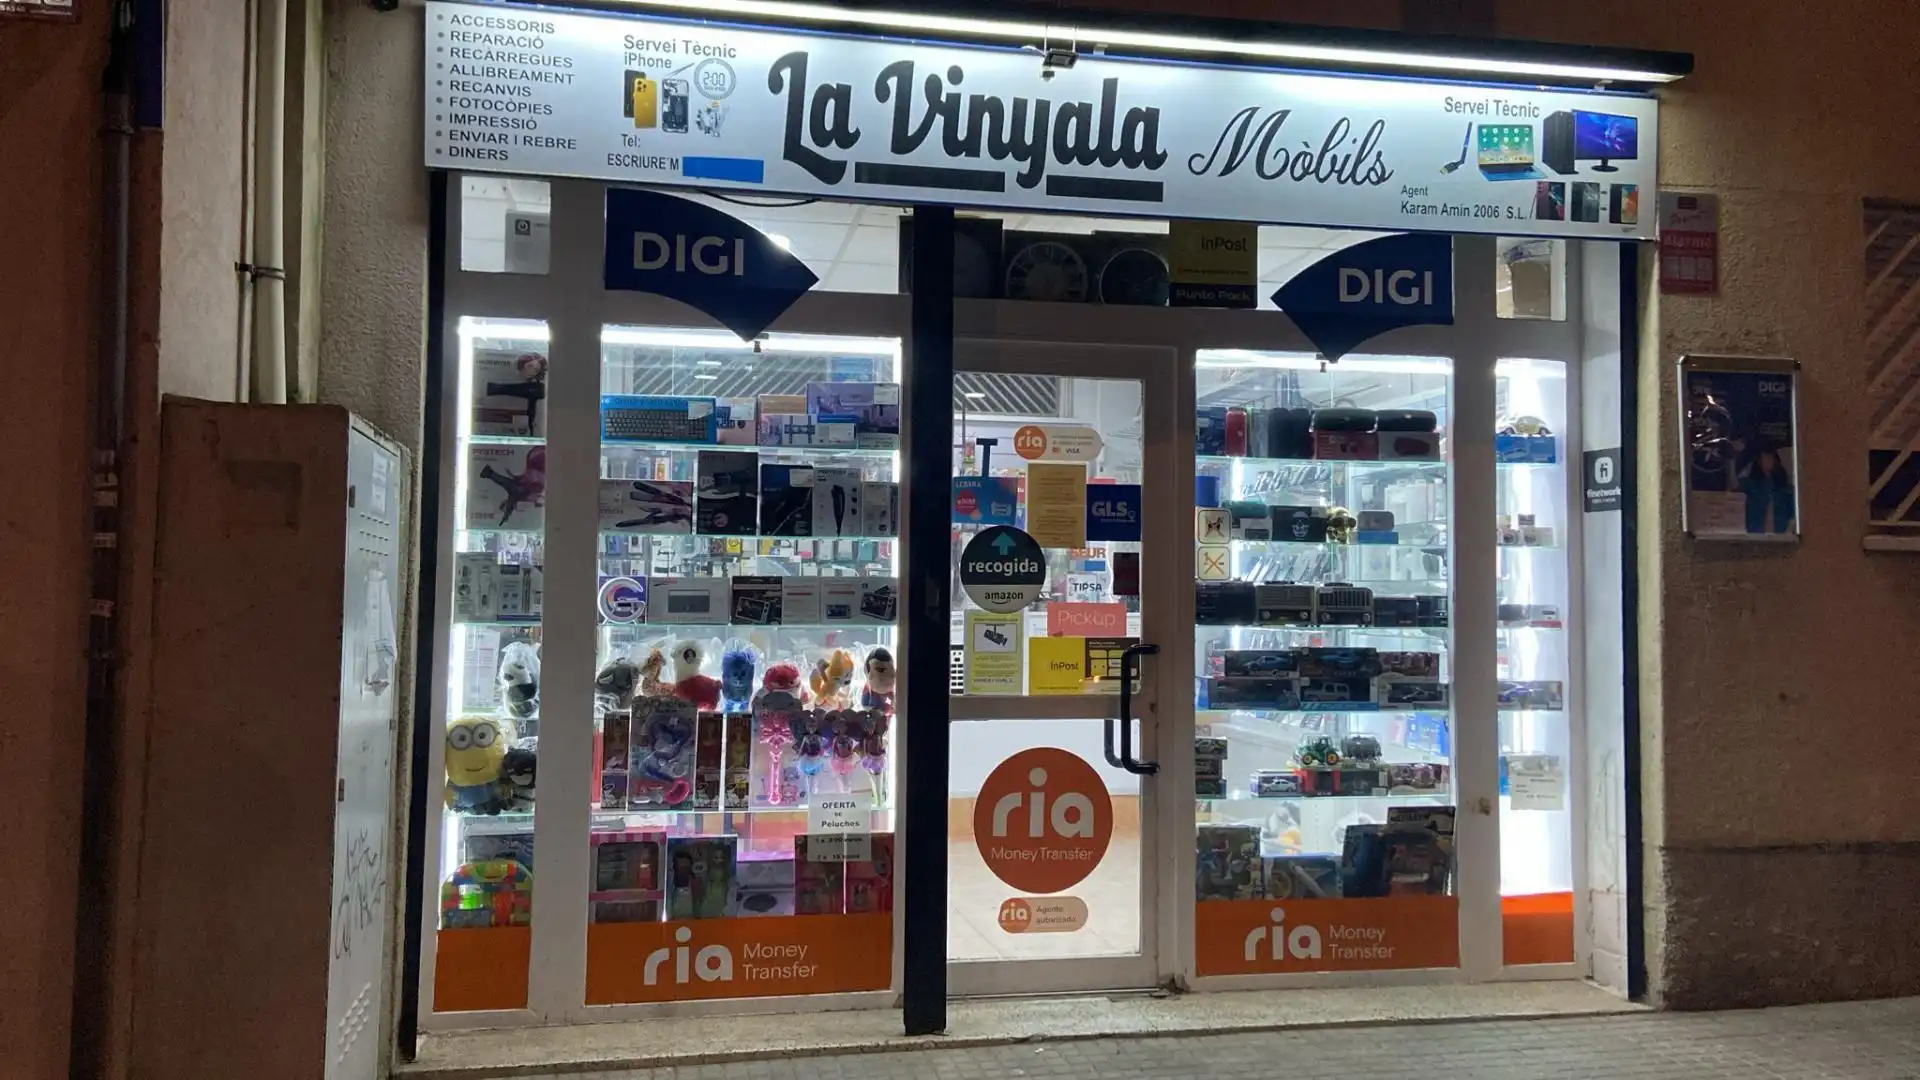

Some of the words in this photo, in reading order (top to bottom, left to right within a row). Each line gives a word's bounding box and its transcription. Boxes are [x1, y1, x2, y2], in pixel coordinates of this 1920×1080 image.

[450, 14, 555, 34] ACCESSORIS
[450, 30, 544, 49] REPARACIÓ
[624, 34, 676, 53] Servei
[682, 40, 737, 59] Tècnic
[624, 52, 672, 69] iPhone
[450, 63, 575, 85] ALLIBREAMENT
[450, 80, 532, 97] RECANVIS
[450, 96, 553, 116] FOTOCÒPIES
[1443, 97, 1490, 116] Servei
[1493, 98, 1541, 119] Tècnic
[450, 113, 538, 131] IMPRESSIÓ
[768, 51, 861, 186] La
[874, 59, 1168, 189] Vinyala
[449, 129, 509, 145] ENVIAR
[514, 134, 518, 145] I
[523, 135, 577, 150] REBRE
[621, 133, 641, 148] Tel:
[1187, 106, 1395, 186] Mòbils
[449, 146, 509, 161] DINERS
[1401, 184, 1428, 198] Agent
[1401, 201, 1438, 216] Karam
[1441, 202, 1470, 217] Amin
[1474, 204, 1500, 219] 2006
[1201, 235, 1249, 251] InPost
[633, 231, 744, 276] DIGI
[1338, 267, 1433, 305] DIGI
[1016, 430, 1045, 448] ria
[1092, 500, 1128, 518] GLS
[968, 558, 1039, 577] recogida
[984, 591, 1024, 600] amazon
[1072, 582, 1102, 592] TIPSA
[1057, 609, 1116, 627] Pickup
[1050, 661, 1079, 670] InPost
[822, 801, 856, 809] OFERTA
[992, 767, 1095, 839] ria
[821, 820, 860, 828] Peluches
[990, 847, 1037, 863] Money
[1040, 847, 1093, 861] Transfer
[1001, 903, 1028, 921] ria
[1244, 907, 1321, 961] ria
[1329, 924, 1386, 943] Money
[644, 926, 733, 986] ria
[743, 943, 808, 960] Money
[1328, 943, 1395, 960] Transfer
[742, 960, 818, 980] Transfer
